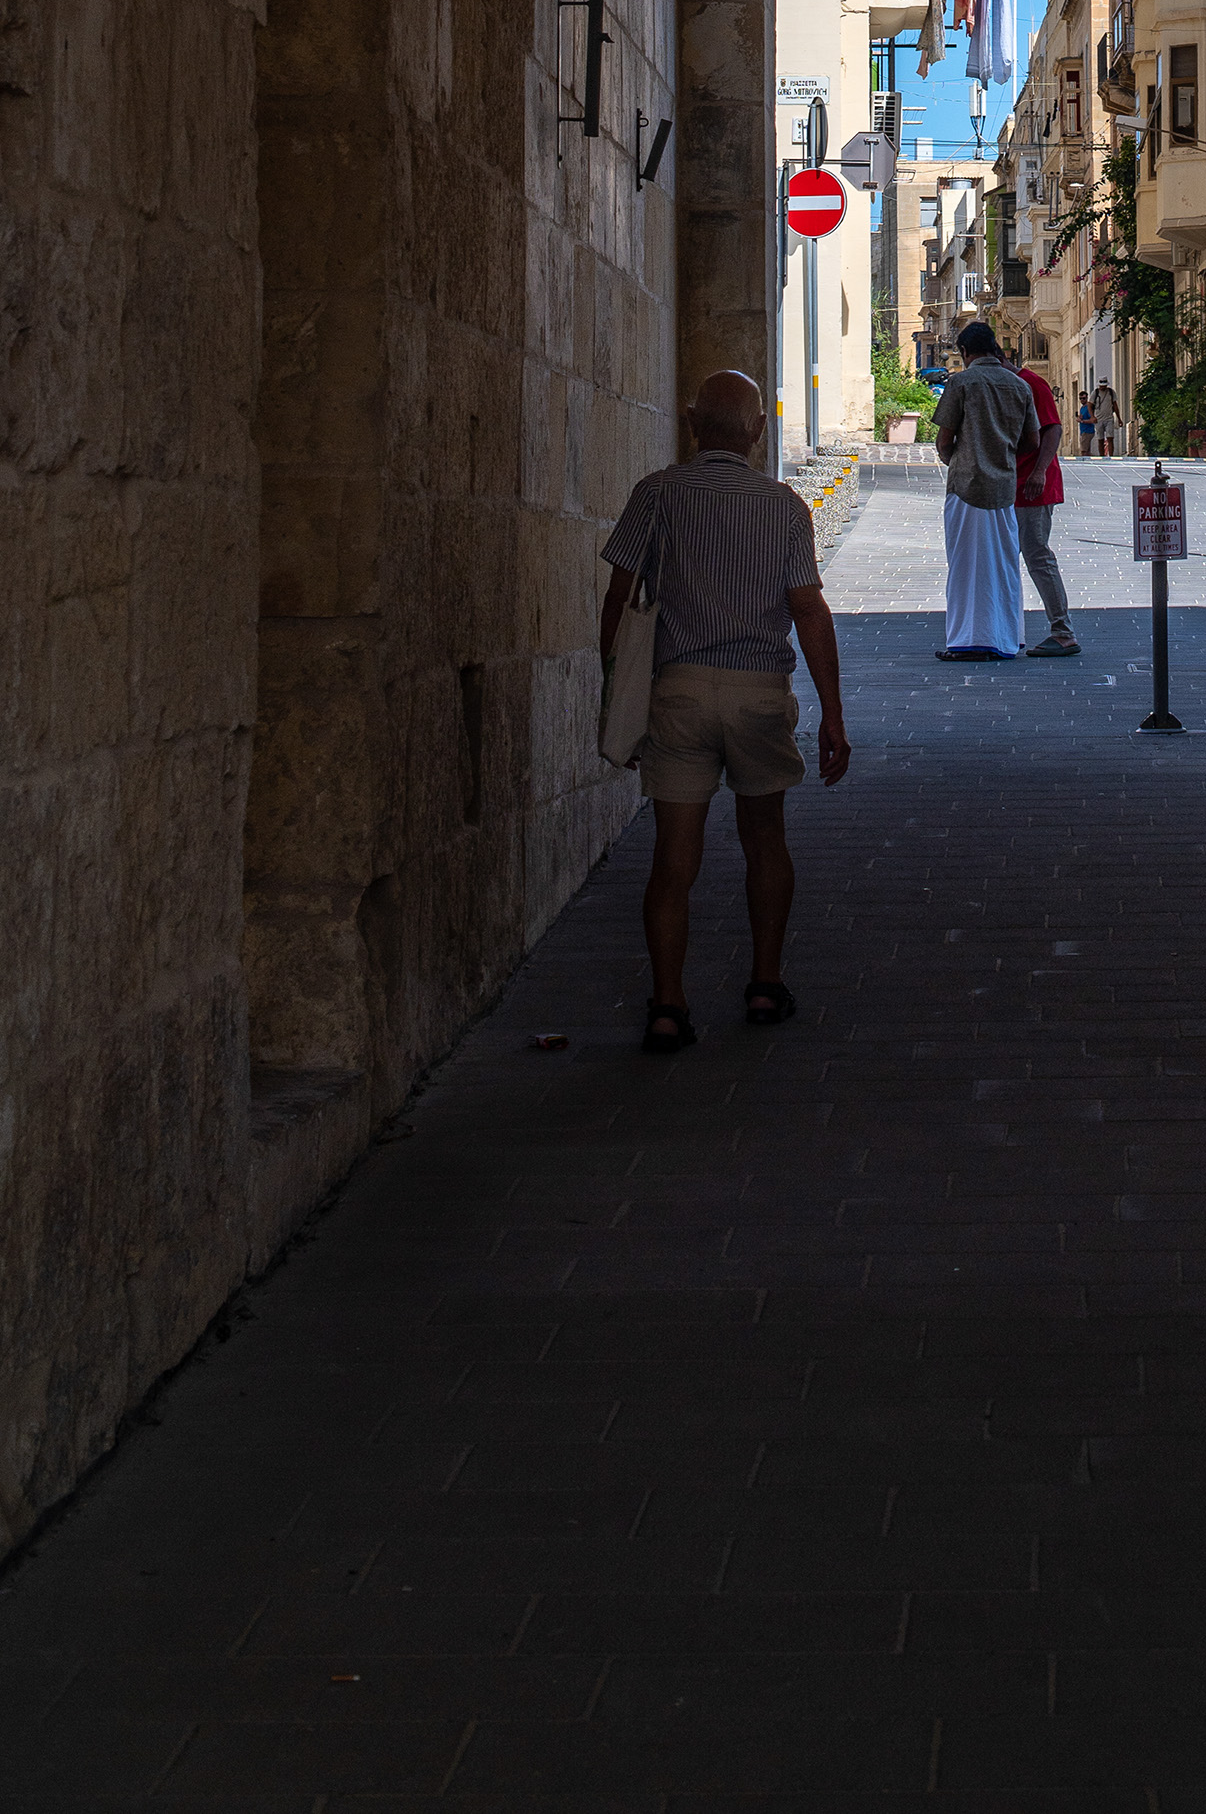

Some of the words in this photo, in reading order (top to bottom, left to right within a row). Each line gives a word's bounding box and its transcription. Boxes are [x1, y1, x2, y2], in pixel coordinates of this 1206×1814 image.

[1153, 492, 1166, 504] NO
[1139, 506, 1180, 519] PARKING
[1143, 525, 1159, 534] KEEP
[1162, 524, 1178, 532] AREA
[1151, 535, 1171, 543] CLEAR
